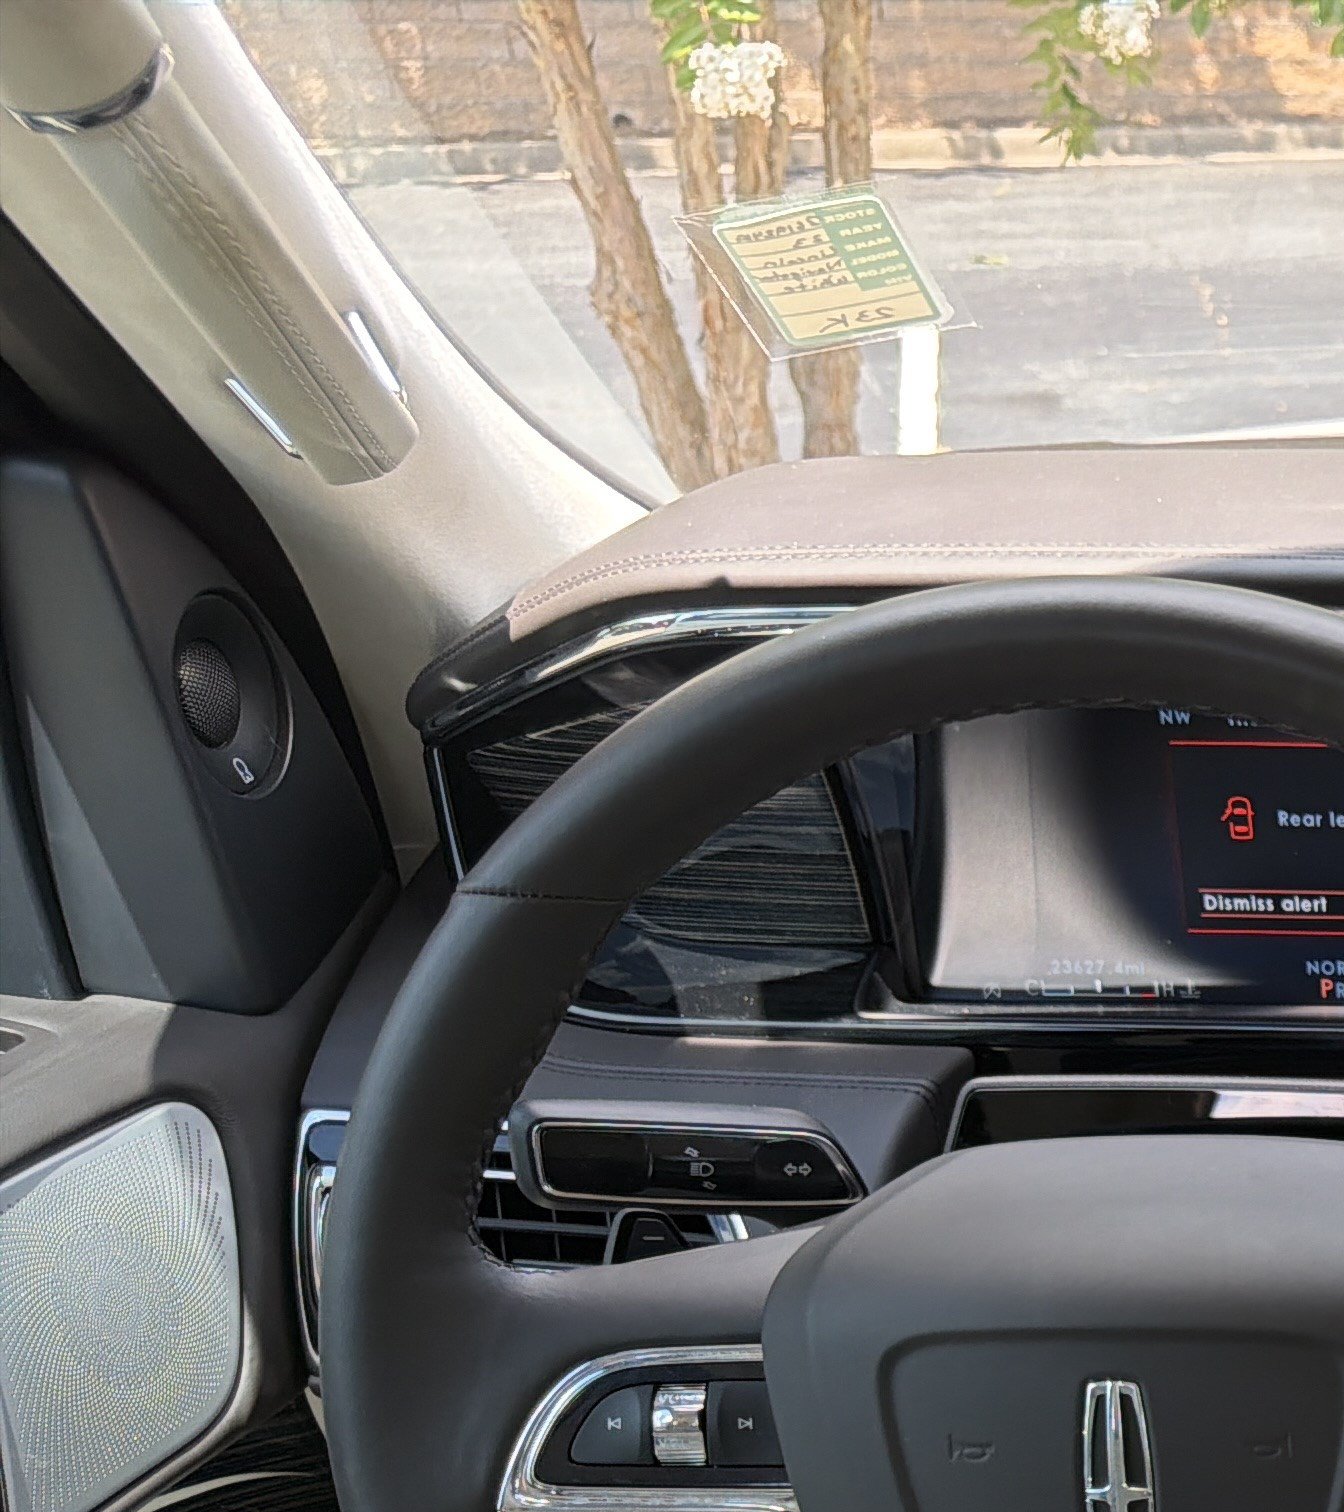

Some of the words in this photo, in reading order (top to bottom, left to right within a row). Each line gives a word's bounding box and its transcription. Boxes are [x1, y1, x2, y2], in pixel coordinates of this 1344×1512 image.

[1159, 710, 1190, 725] NW
[1277, 809, 1322, 828] Rear
[1203, 893, 1275, 912] Dismiss
[1281, 896, 1328, 913] alert
